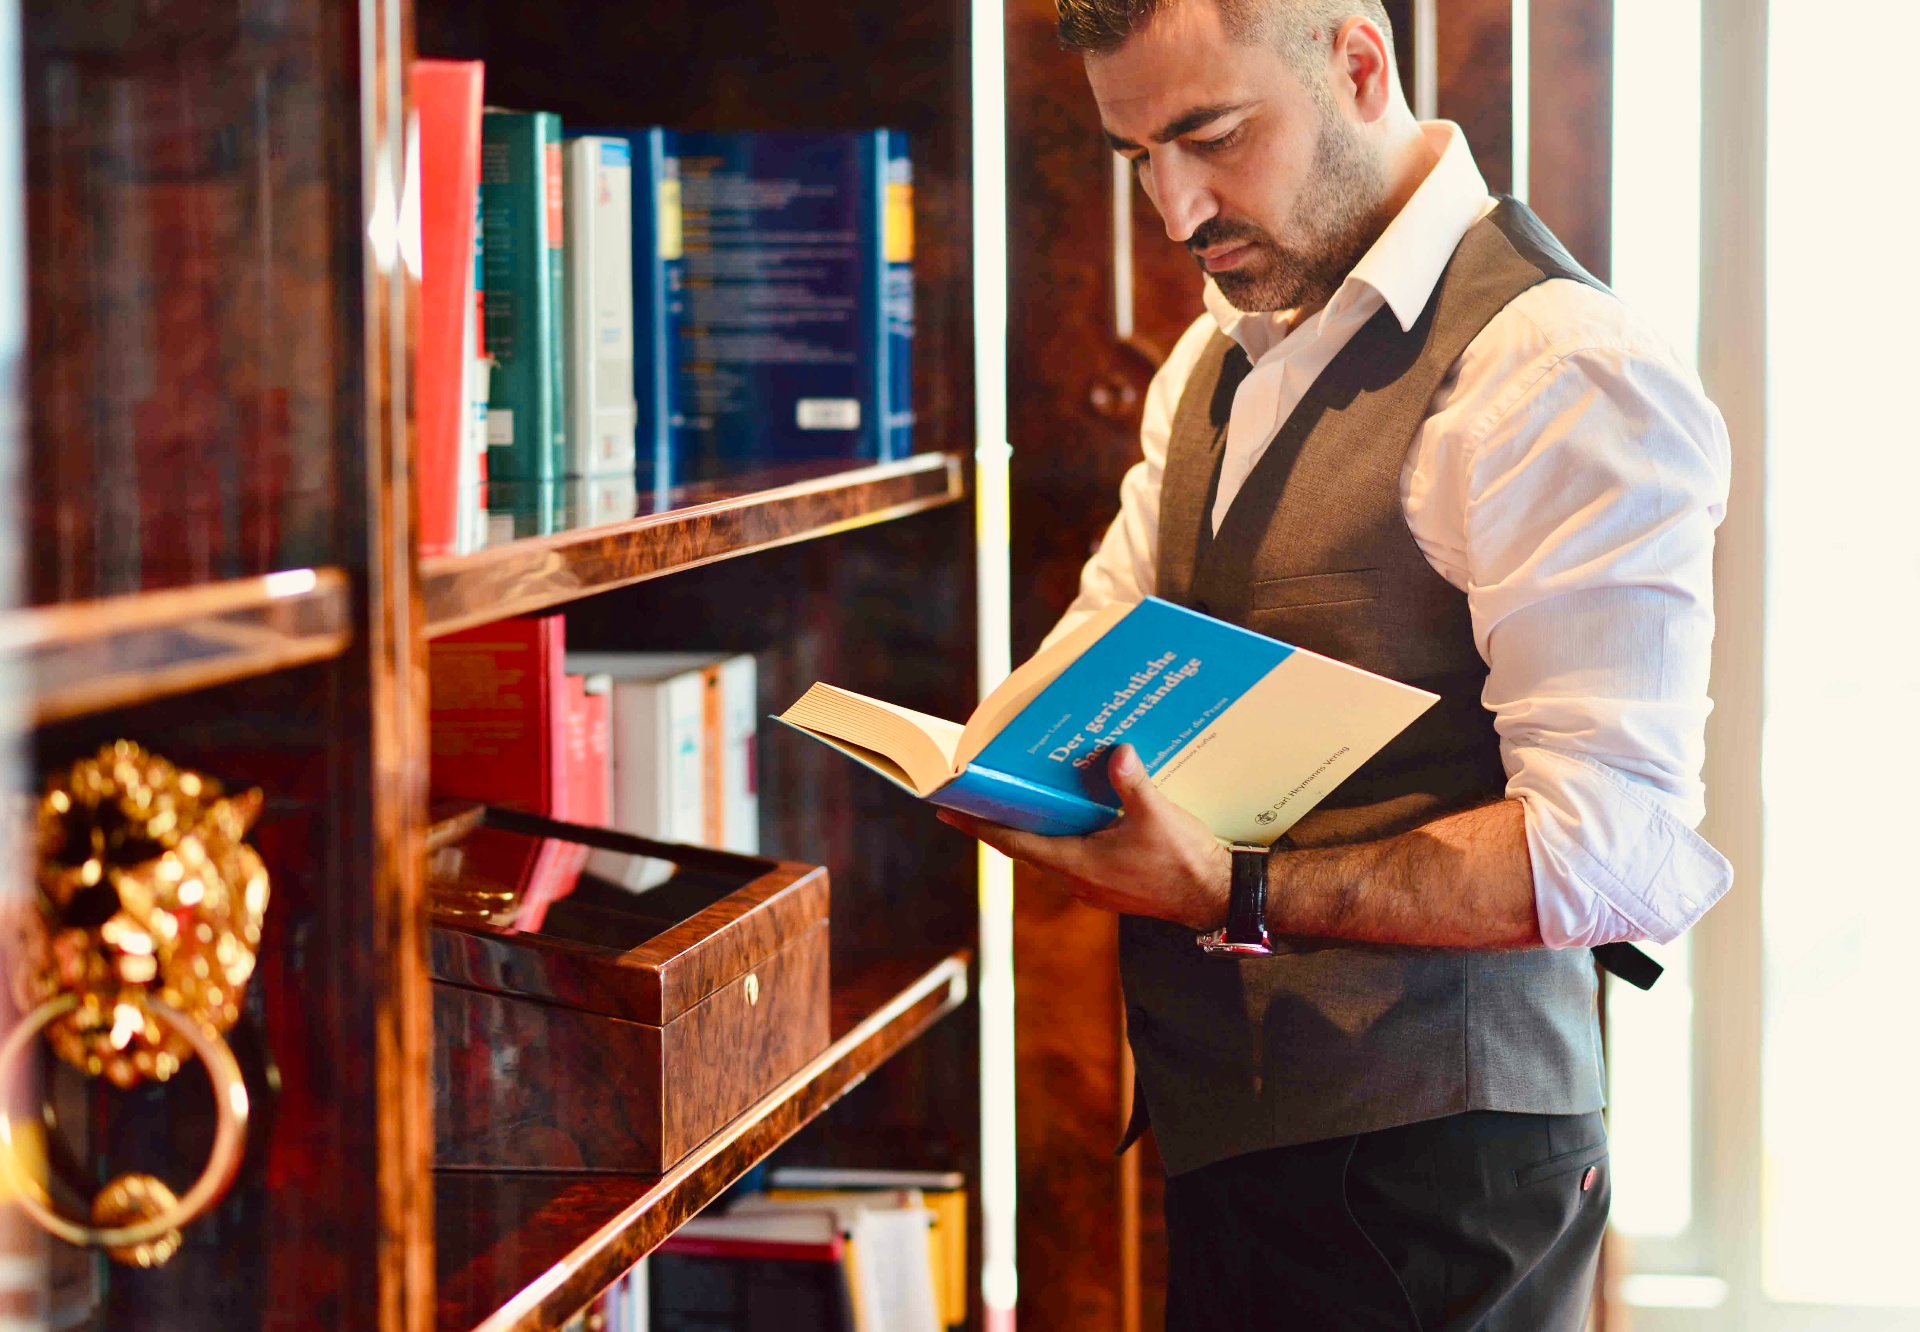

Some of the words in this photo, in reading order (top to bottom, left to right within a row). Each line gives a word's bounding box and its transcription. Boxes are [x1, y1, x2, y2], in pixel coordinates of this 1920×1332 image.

[1048, 732, 1086, 762] Der
[1085, 650, 1177, 733] gerichtliche
[1072, 657, 1202, 769] Sachverständige
[1192, 717, 1205, 728] die
[1273, 795, 1290, 810] Carl
[1288, 765, 1326, 797] Heymanns
[1322, 745, 1350, 766] Verlag
